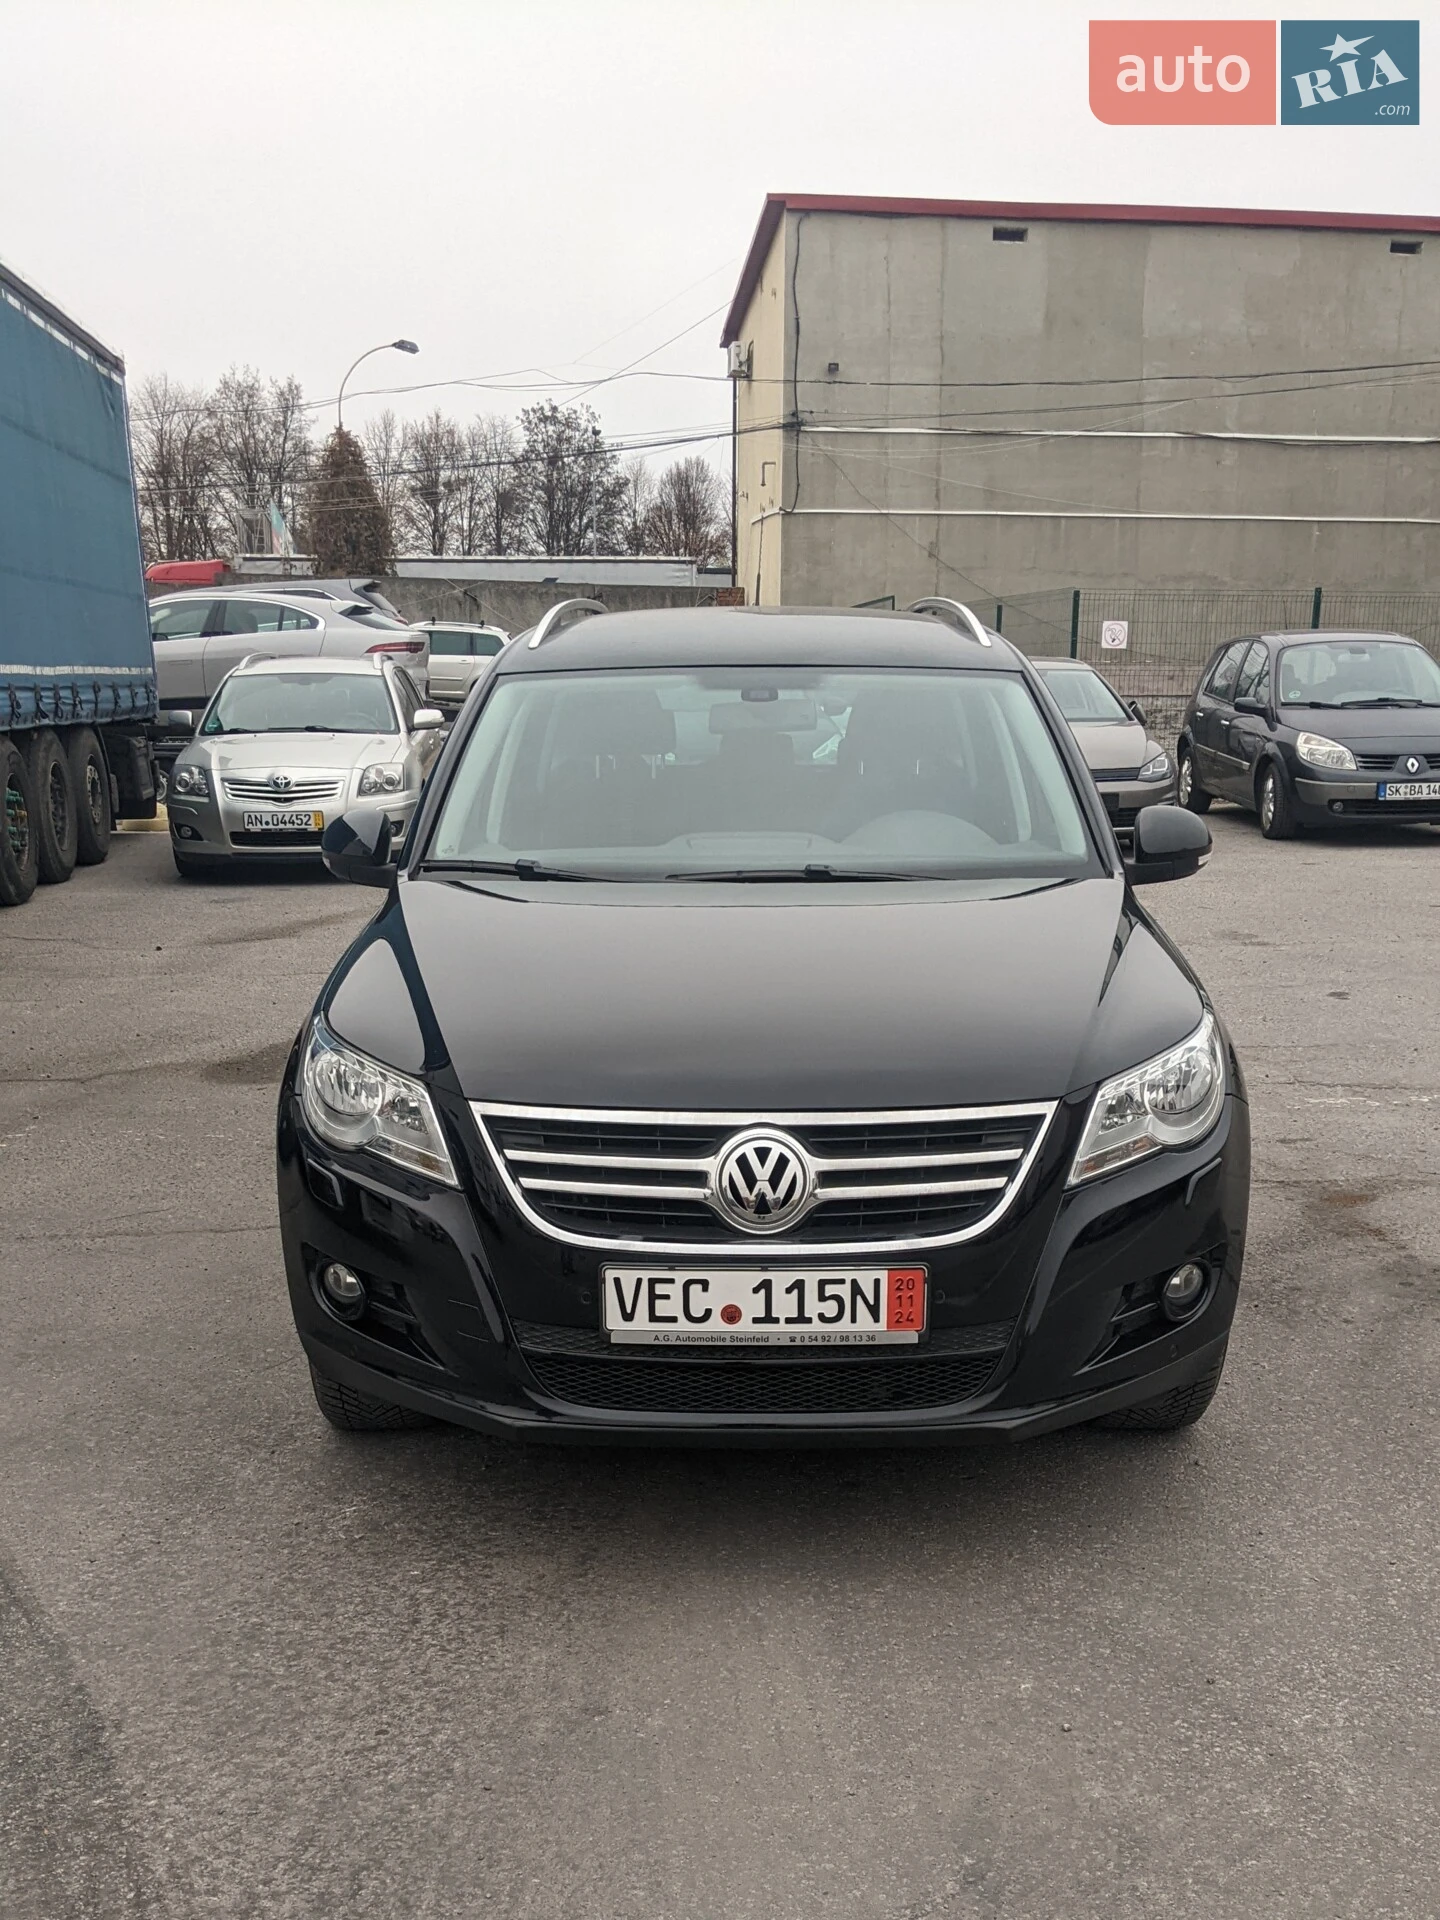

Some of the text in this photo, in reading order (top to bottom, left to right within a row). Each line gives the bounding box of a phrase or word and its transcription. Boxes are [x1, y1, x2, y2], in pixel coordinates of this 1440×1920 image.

[1388, 785, 1402, 796] SK
[1409, 785, 1423, 796] BA
[246, 814, 263, 827] AN
[271, 813, 312, 827] 04452
[895, 1277, 915, 1291] 20
[612, 1277, 881, 1325] VEC 115N
[895, 1293, 914, 1308] 11
[894, 1310, 915, 1324] 24
[653, 1334, 673, 1342] A.G.
[675, 1334, 727, 1343] Automobile
[729, 1335, 770, 1343] Steinfeld
